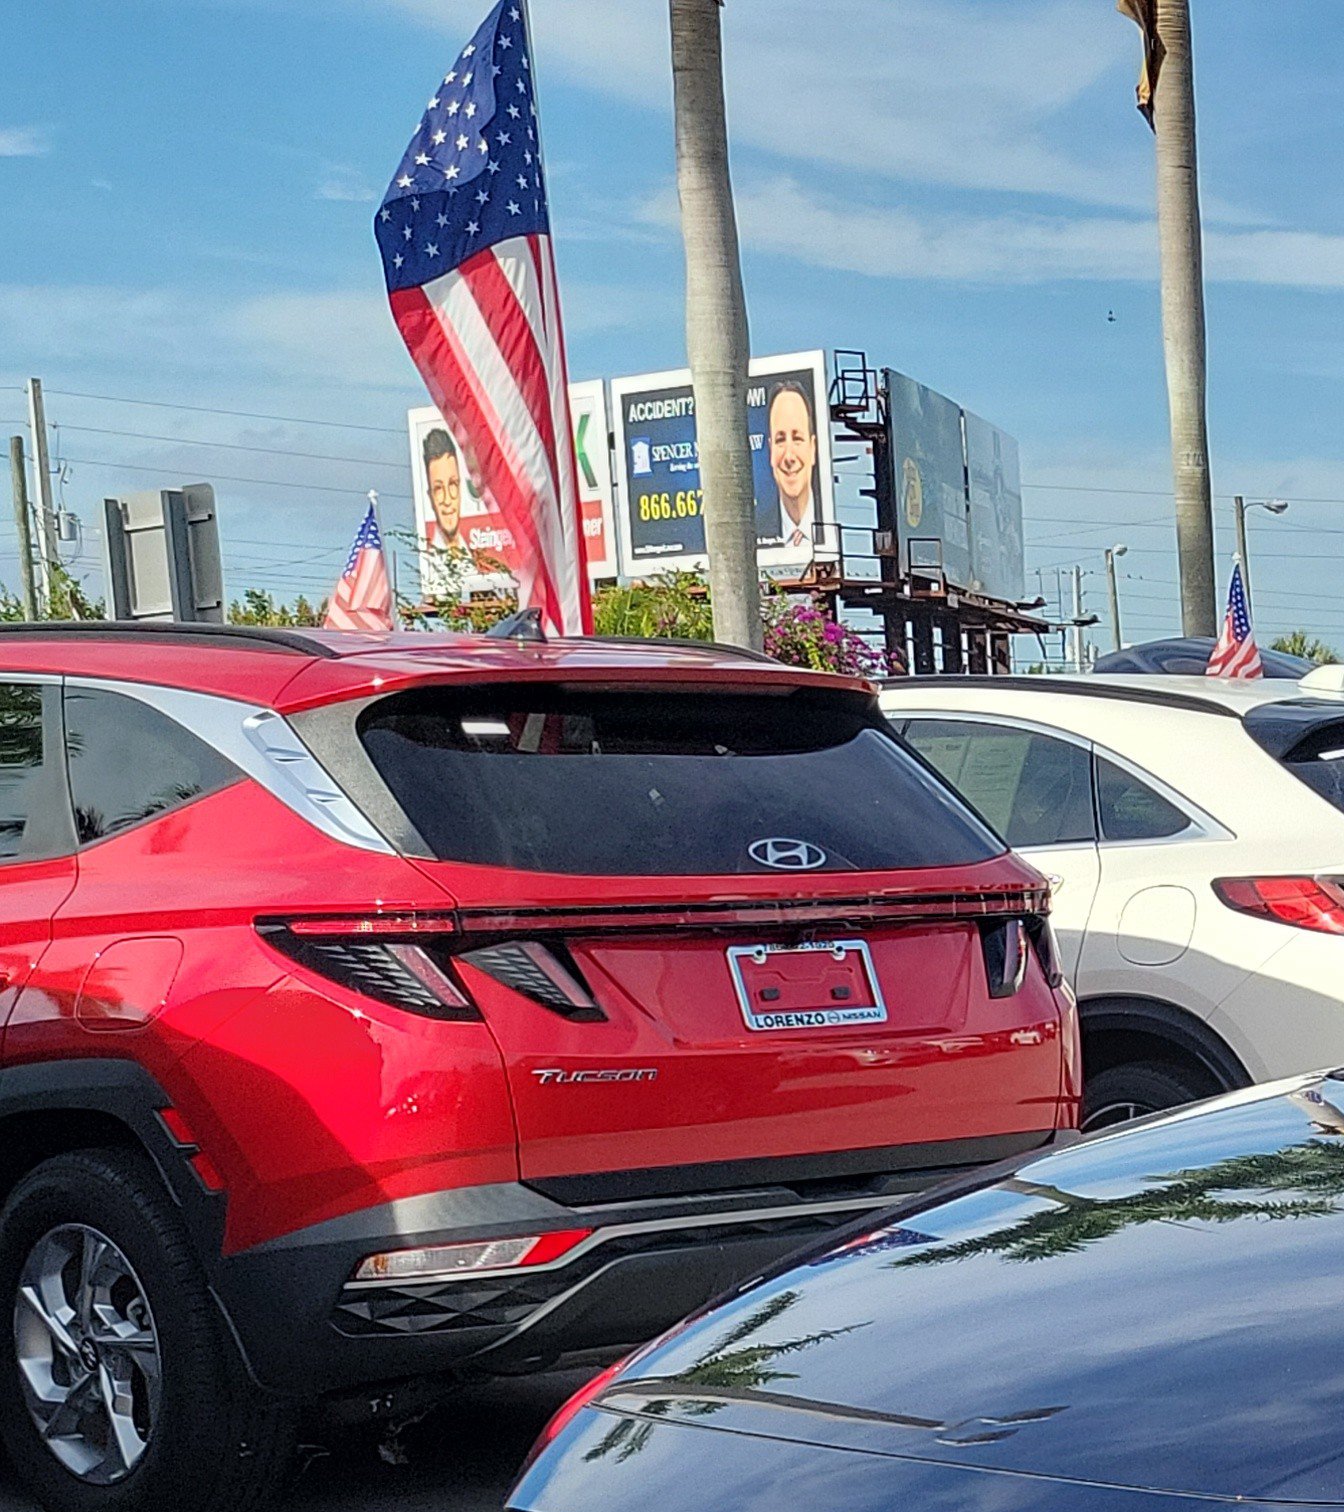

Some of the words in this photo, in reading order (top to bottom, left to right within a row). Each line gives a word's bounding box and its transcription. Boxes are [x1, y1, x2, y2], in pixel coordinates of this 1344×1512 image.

[628, 396, 694, 422] ACCIDENT?
[652, 442, 694, 461] SPENCER
[754, 1012, 826, 1029] LORENZO
[842, 1011, 881, 1021] NISSAN
